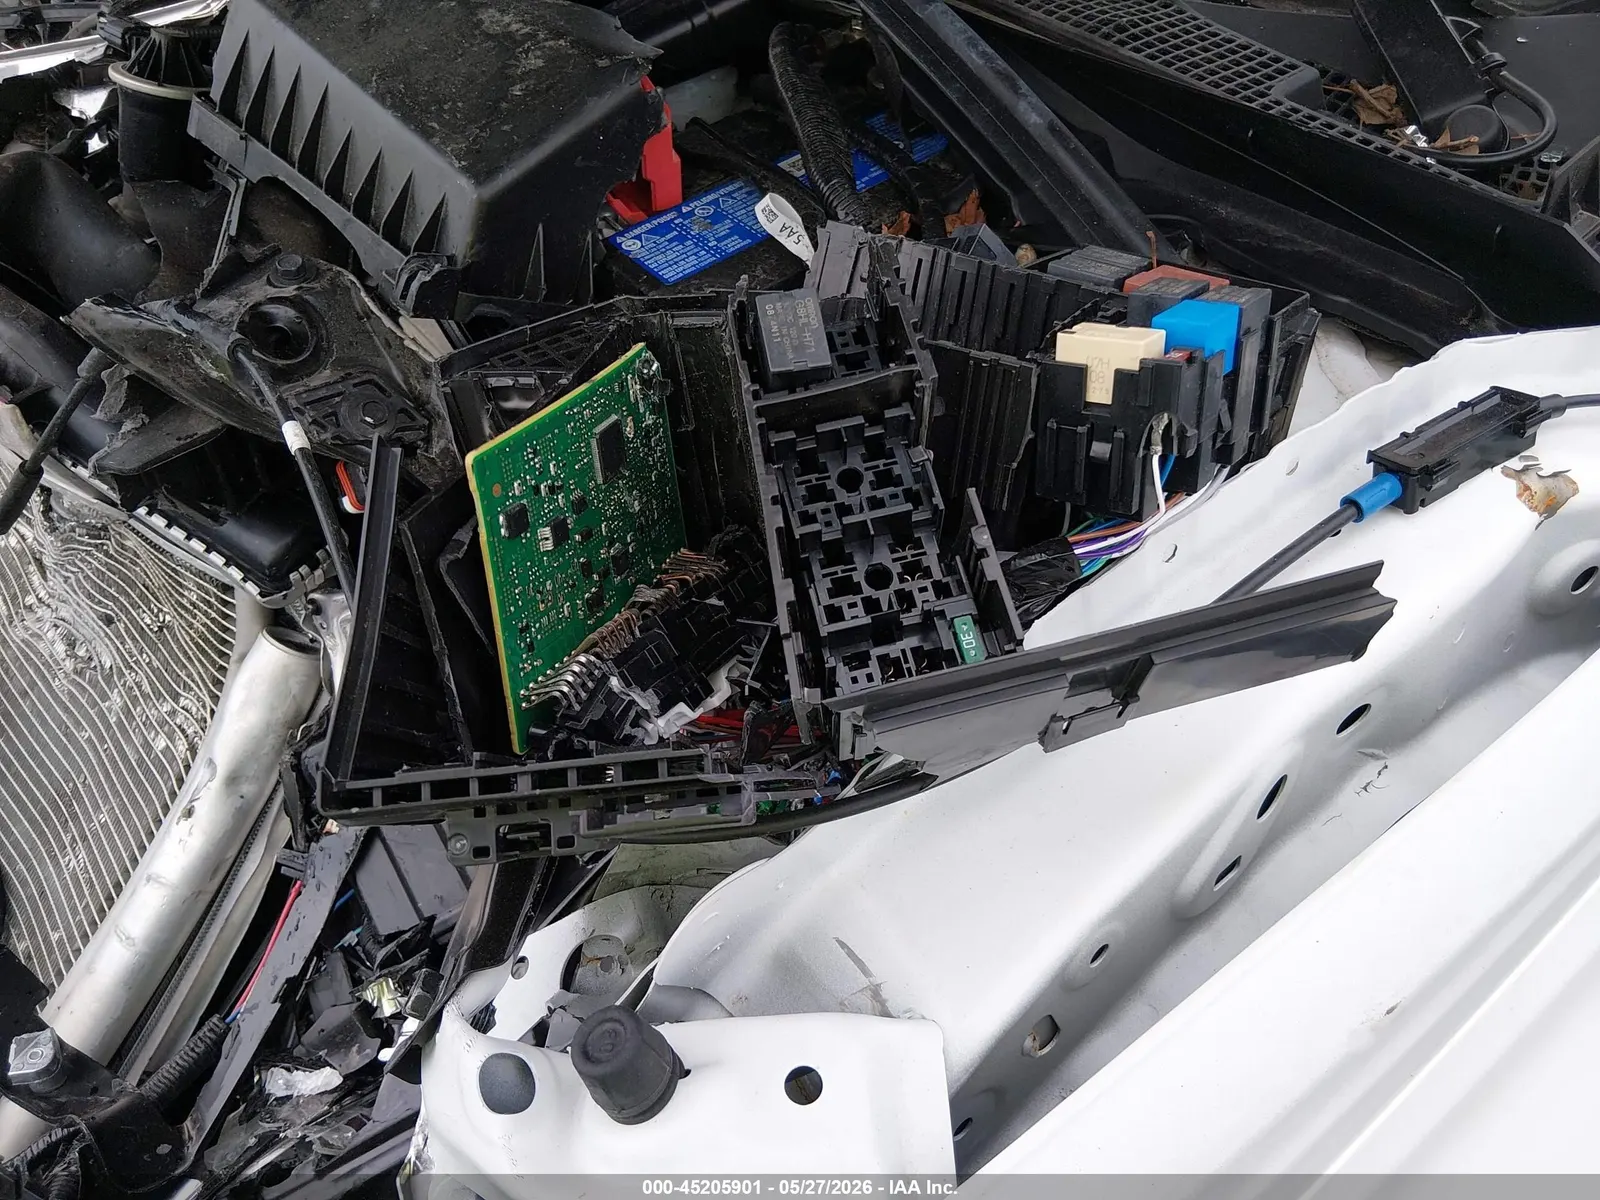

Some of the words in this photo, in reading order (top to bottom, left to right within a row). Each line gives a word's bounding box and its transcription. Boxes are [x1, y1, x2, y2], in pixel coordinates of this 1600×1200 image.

[780, 222, 804, 245] 5AA
[805, 298, 819, 328] omron
[961, 632, 976, 648] 30
